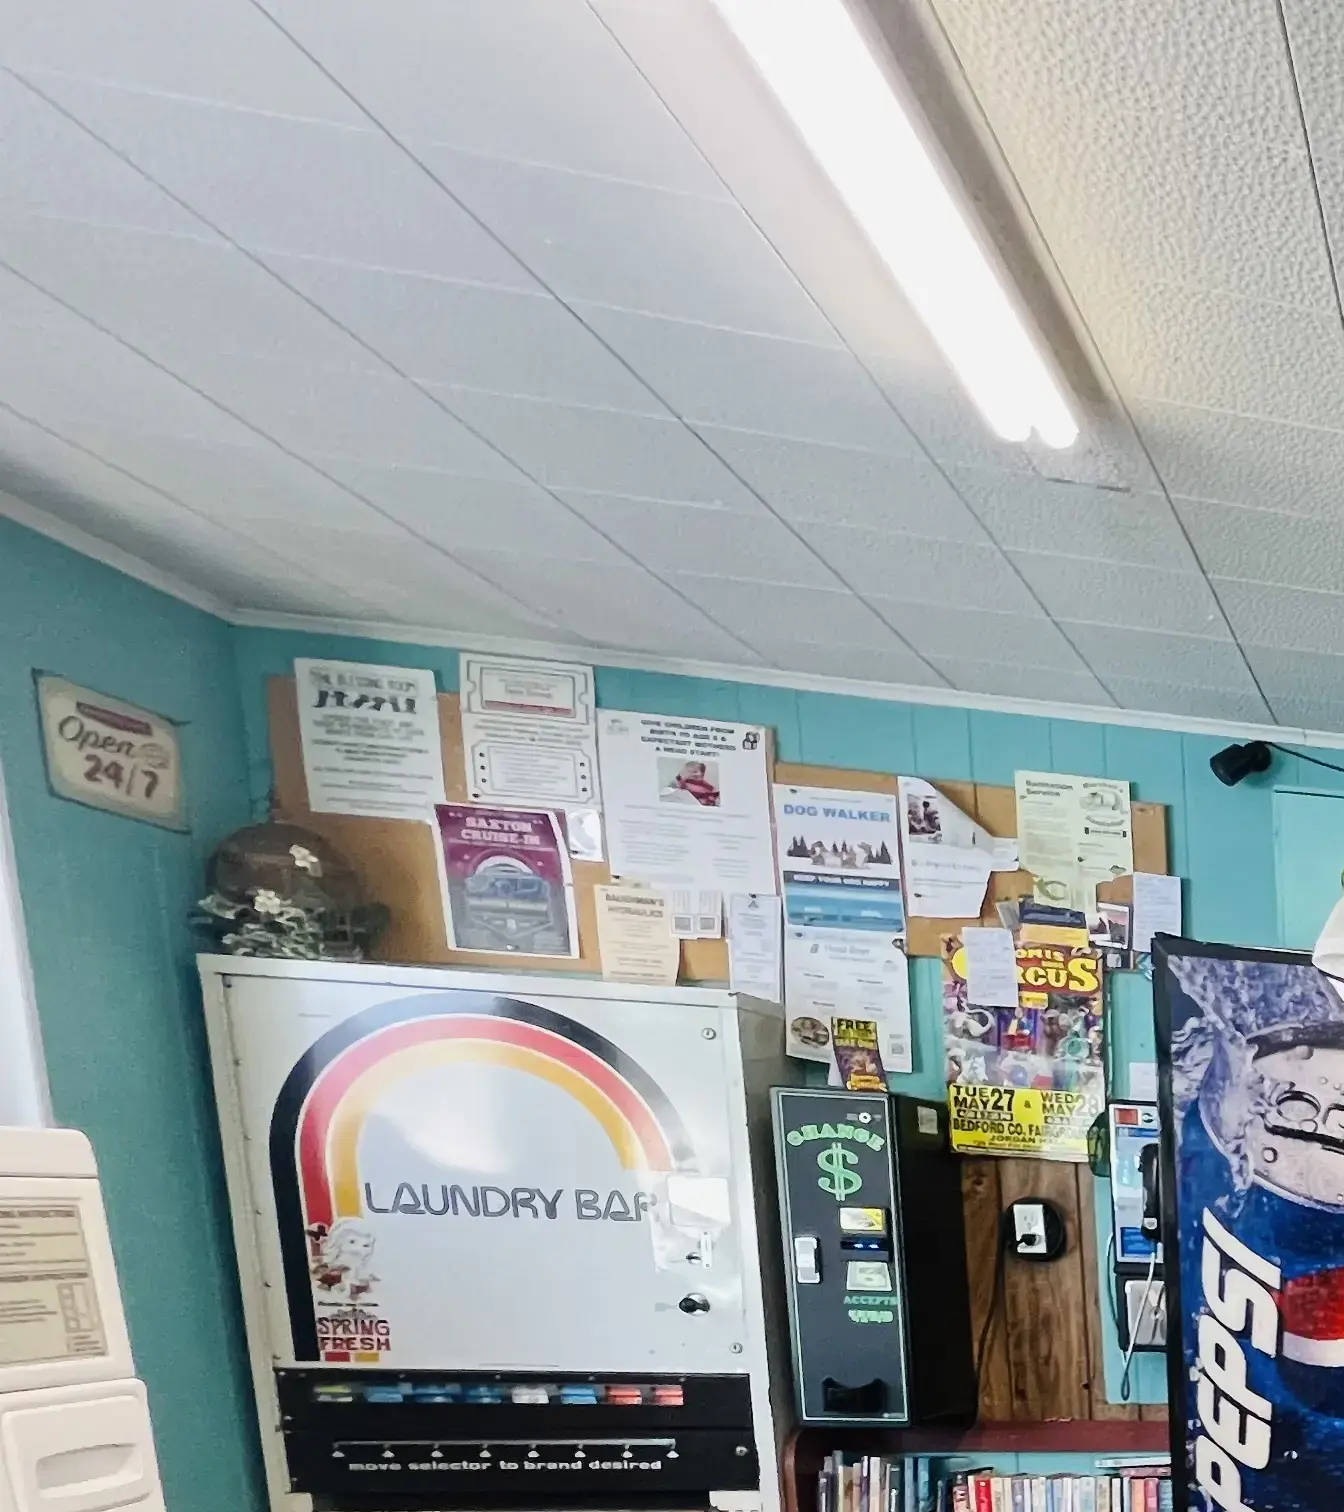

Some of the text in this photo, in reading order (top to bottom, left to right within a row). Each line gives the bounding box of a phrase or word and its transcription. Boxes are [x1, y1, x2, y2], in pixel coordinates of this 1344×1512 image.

[58, 715, 134, 758] Open
[84, 753, 160, 798] 24/7
[783, 804, 891, 823] DOG WALKER
[465, 816, 532, 833] SAXTON
[837, 1018, 873, 1030] FREE
[953, 1084, 988, 1098] TUE
[991, 1088, 1016, 1112] 27
[1040, 1091, 1073, 1104] WED
[953, 1096, 1076, 1116] MAY MAY
[953, 1117, 1005, 1134] BEDFORD
[786, 1123, 886, 1152] CHANGE
[989, 1135, 1036, 1144] JORDAN
[364, 1181, 565, 1220] LAUNDRY
[317, 1317, 391, 1336] SPRING
[317, 1336, 391, 1351] FRESH
[349, 1460, 662, 1471] move selector to brand desired
